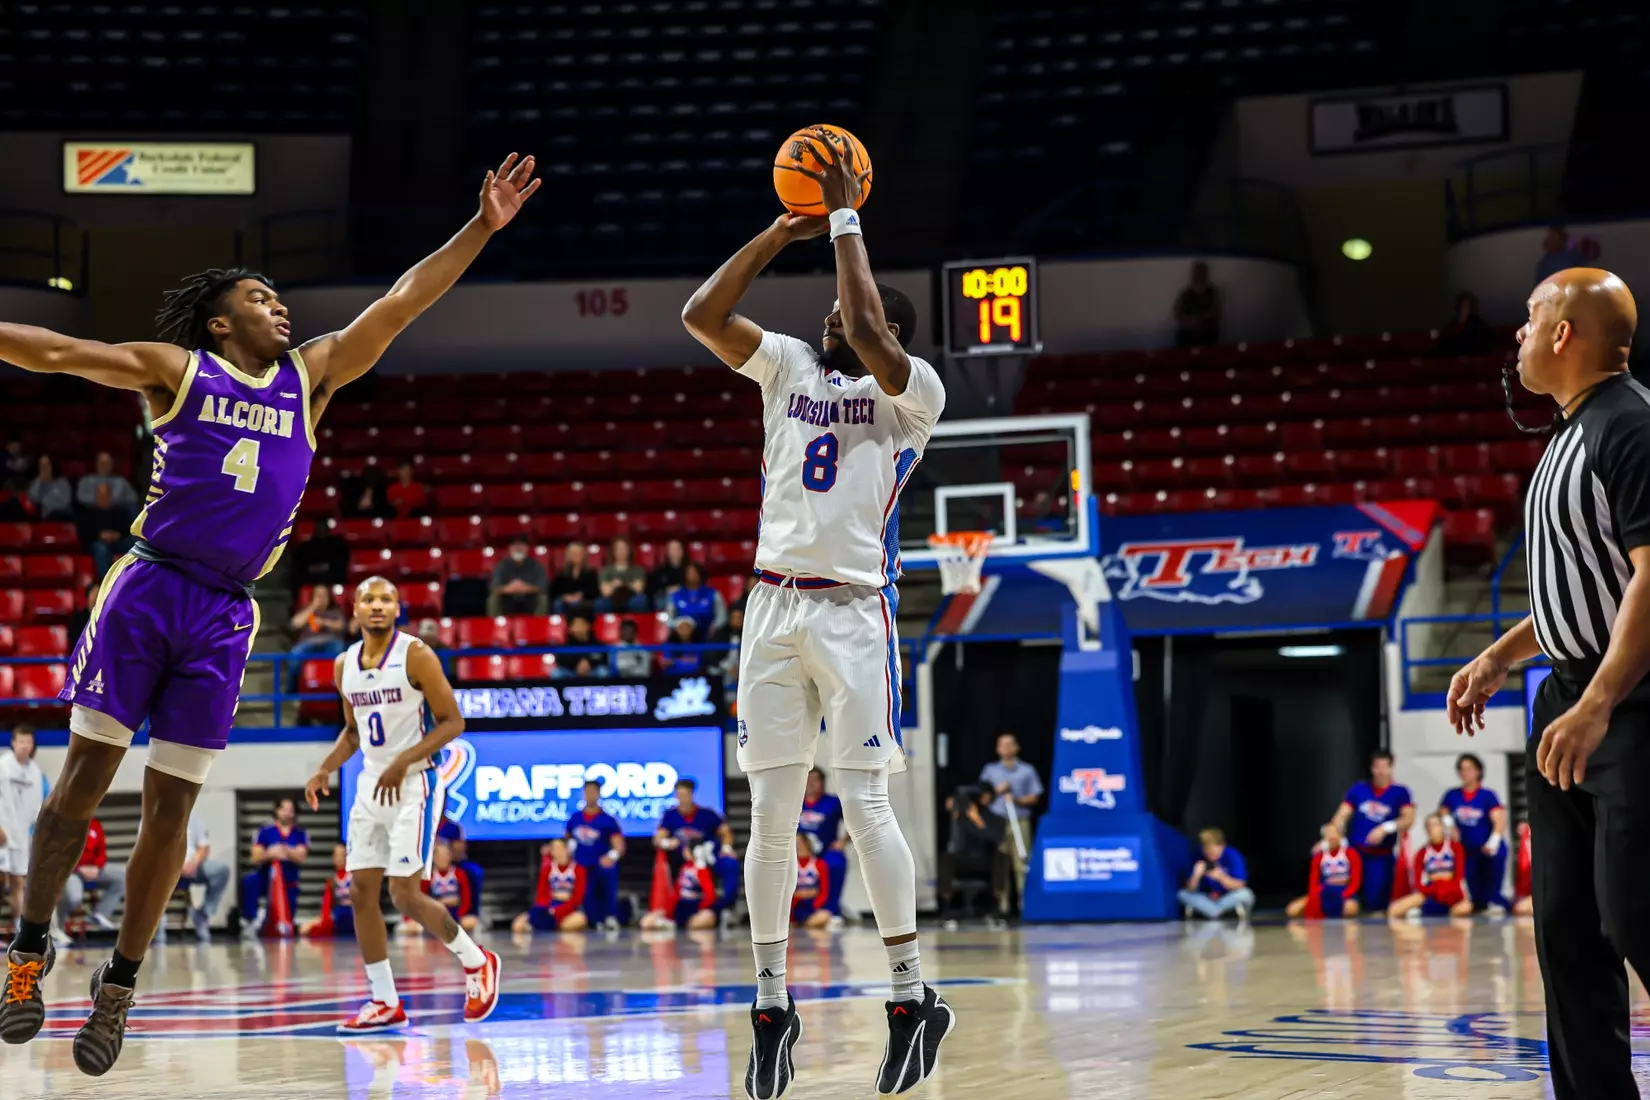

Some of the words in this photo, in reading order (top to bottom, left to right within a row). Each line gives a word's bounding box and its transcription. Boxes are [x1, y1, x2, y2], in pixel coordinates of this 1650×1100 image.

[962, 266, 1028, 299] 10:00
[573, 288, 630, 318] 105
[978, 298, 1021, 344] 19
[197, 394, 295, 439] ALCORN
[842, 397, 876, 426] TECH
[221, 437, 260, 494] 4
[802, 431, 838, 492] 8
[562, 685, 648, 716] TECH
[368, 711, 386, 747] 0
[475, 762, 678, 801] PAFFORD
[475, 800, 572, 823] MEDICAL
